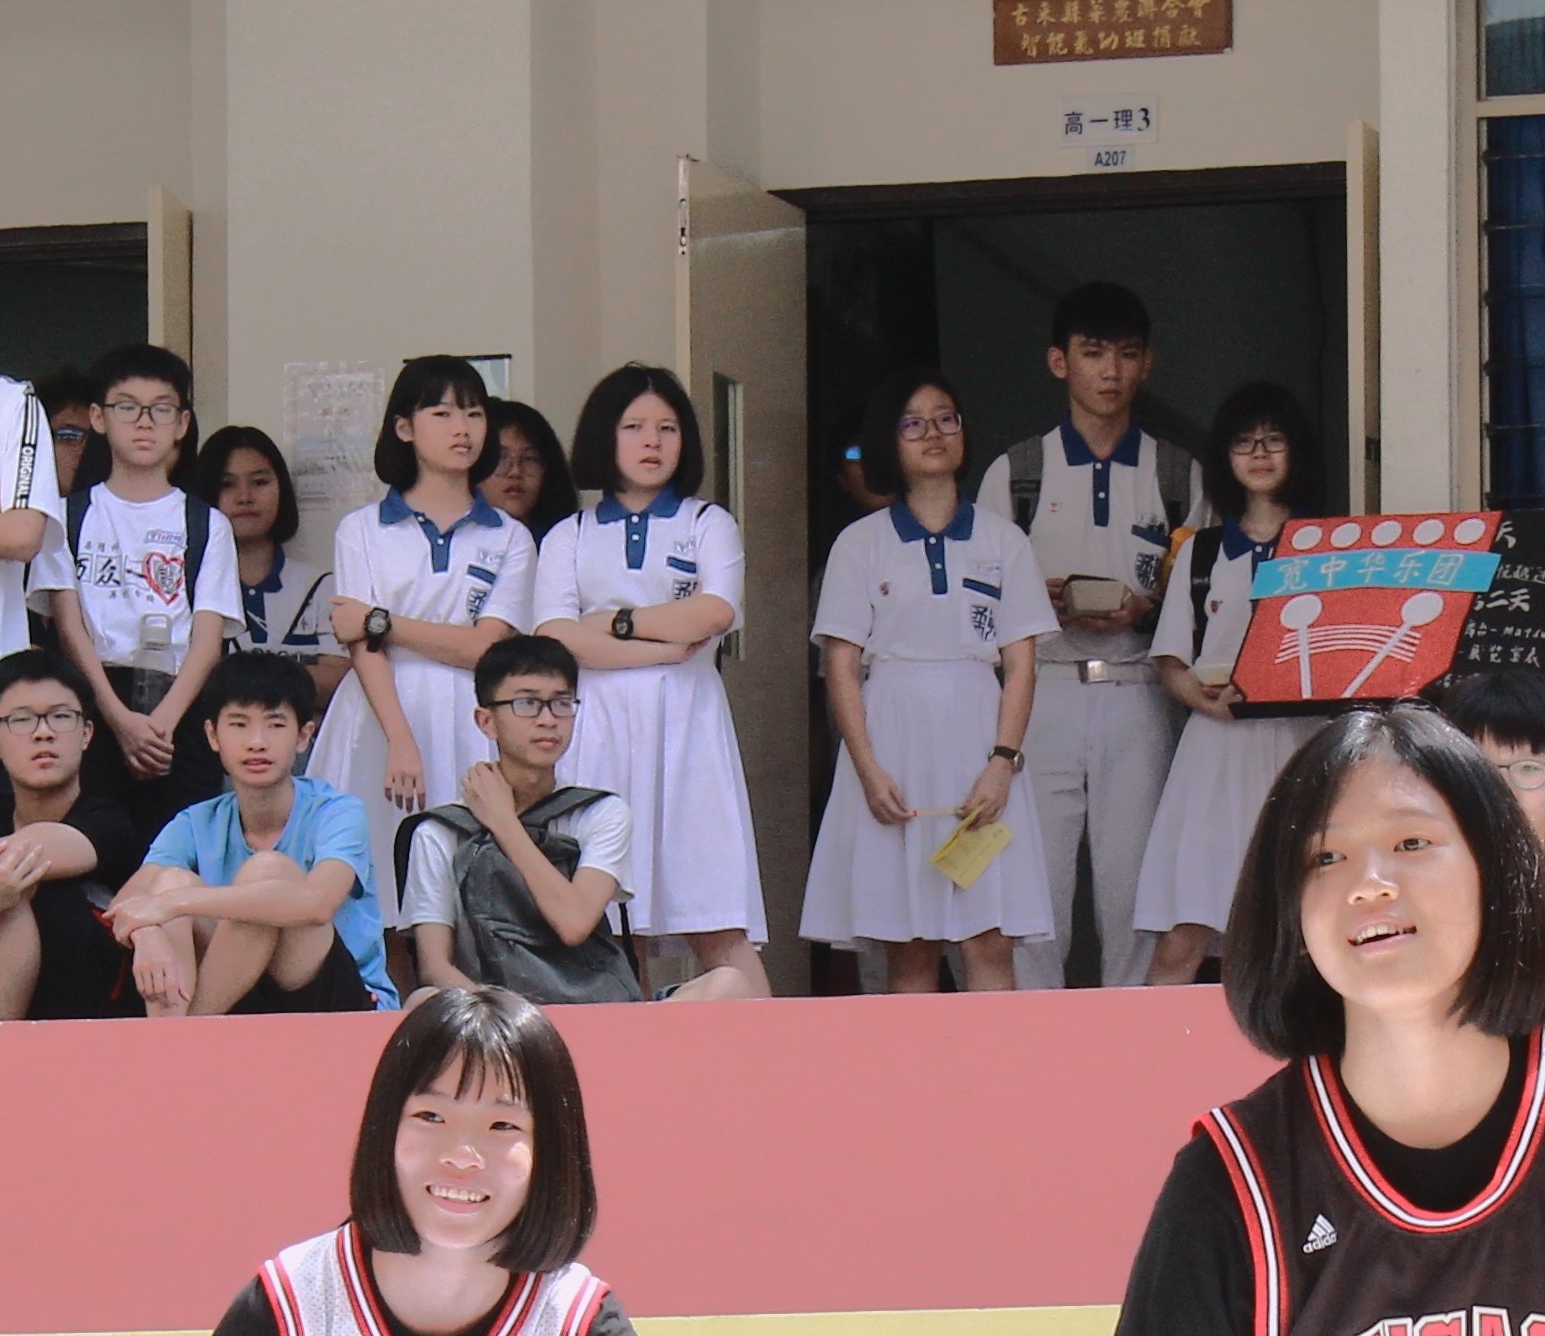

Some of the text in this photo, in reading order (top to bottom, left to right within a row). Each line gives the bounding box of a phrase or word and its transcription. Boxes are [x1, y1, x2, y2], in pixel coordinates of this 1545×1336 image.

[1064, 108, 1151, 136] 高一理3
[1094, 150, 1127, 167] A207
[1275, 551, 1465, 595] 宽中华乐团
